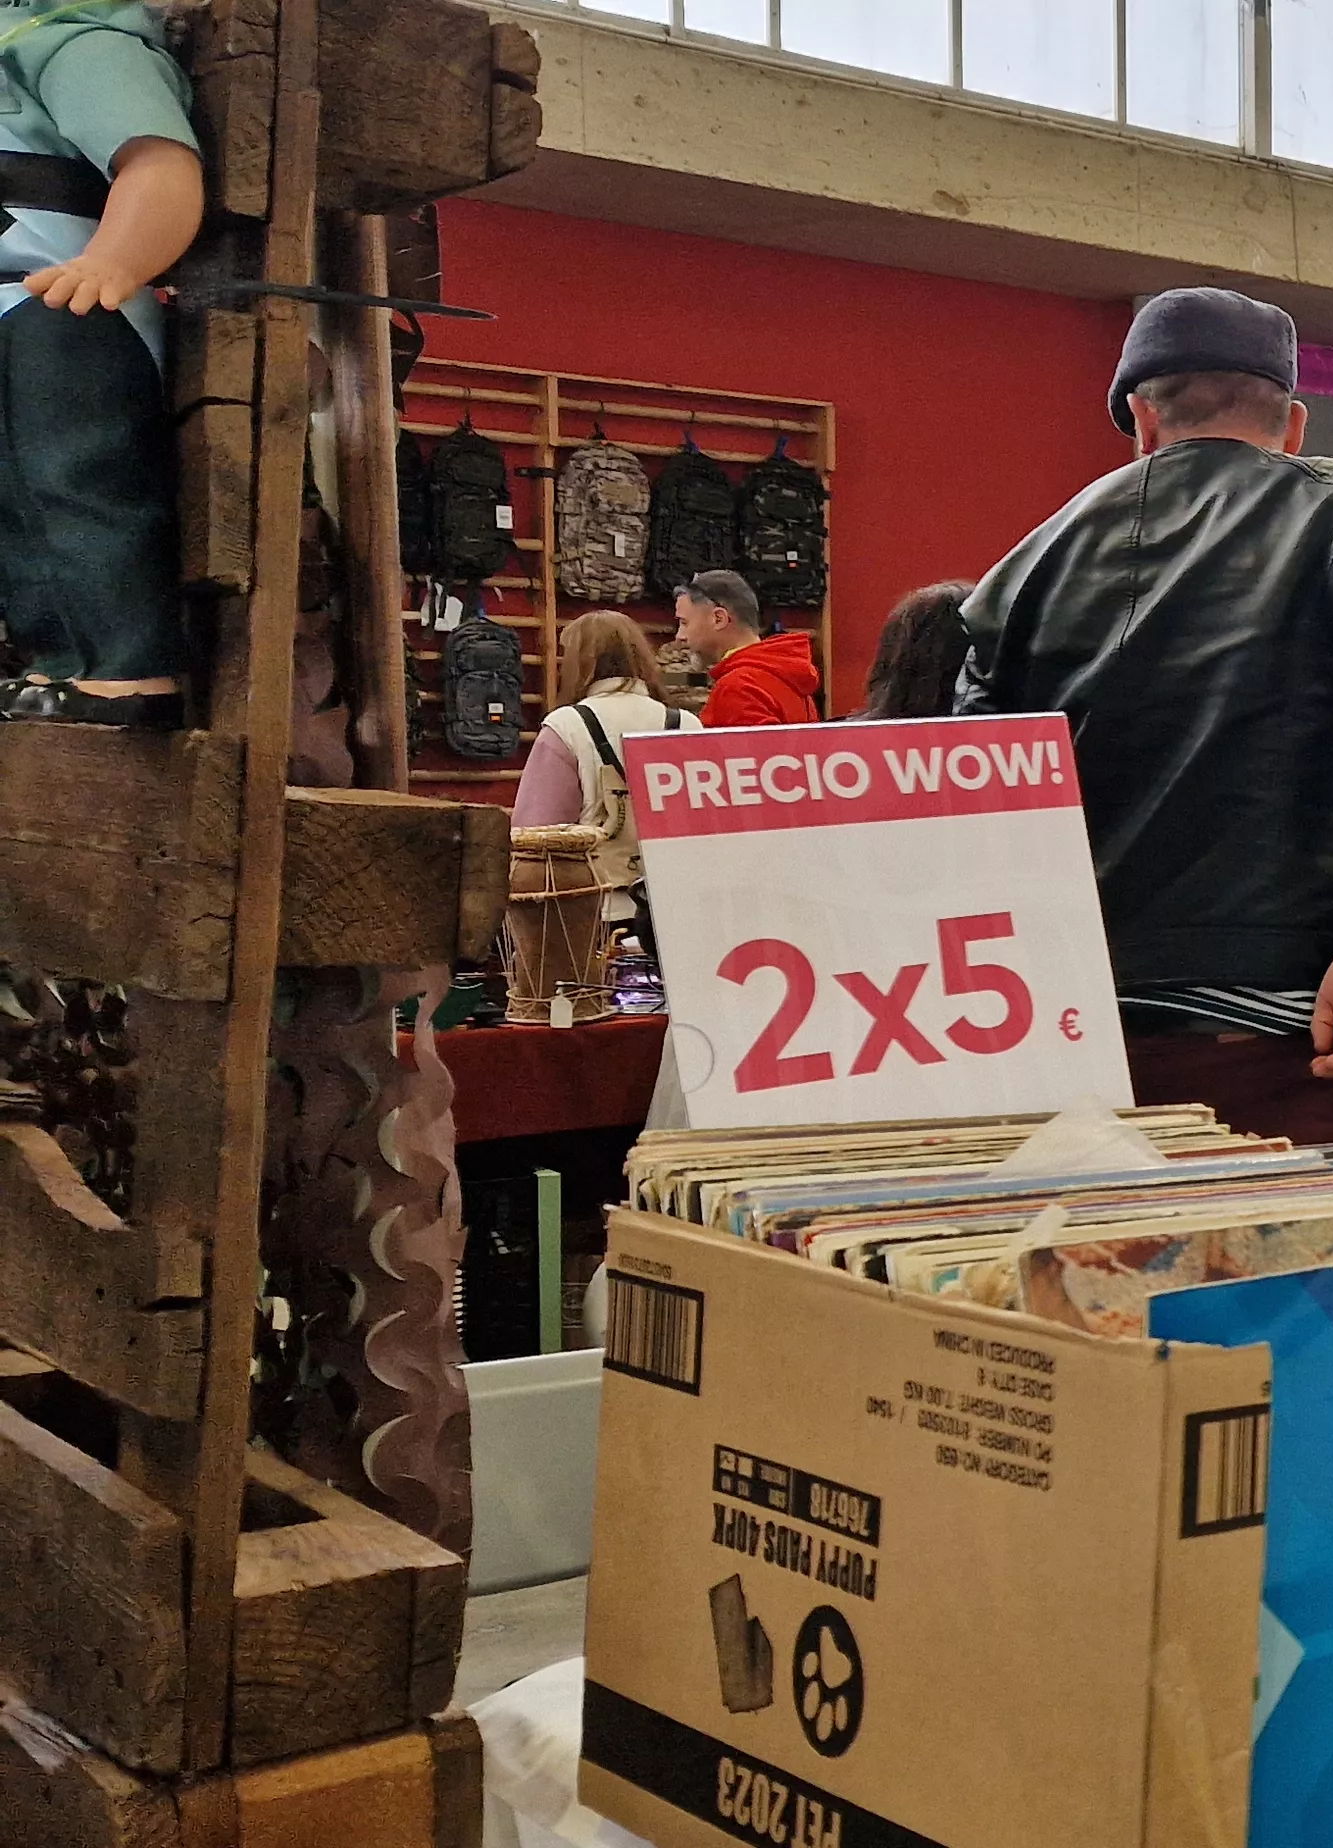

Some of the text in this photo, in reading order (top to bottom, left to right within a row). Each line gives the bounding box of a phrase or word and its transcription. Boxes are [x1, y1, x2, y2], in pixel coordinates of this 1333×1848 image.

[643, 740, 1065, 812] PRECIO WOW!
[716, 911, 1084, 1094] 2x5 €
[712, 1502, 879, 1600] PUPPY PADS 40PK
[809, 1482, 871, 1537] 766718
[716, 1757, 841, 1848] PET 2023
